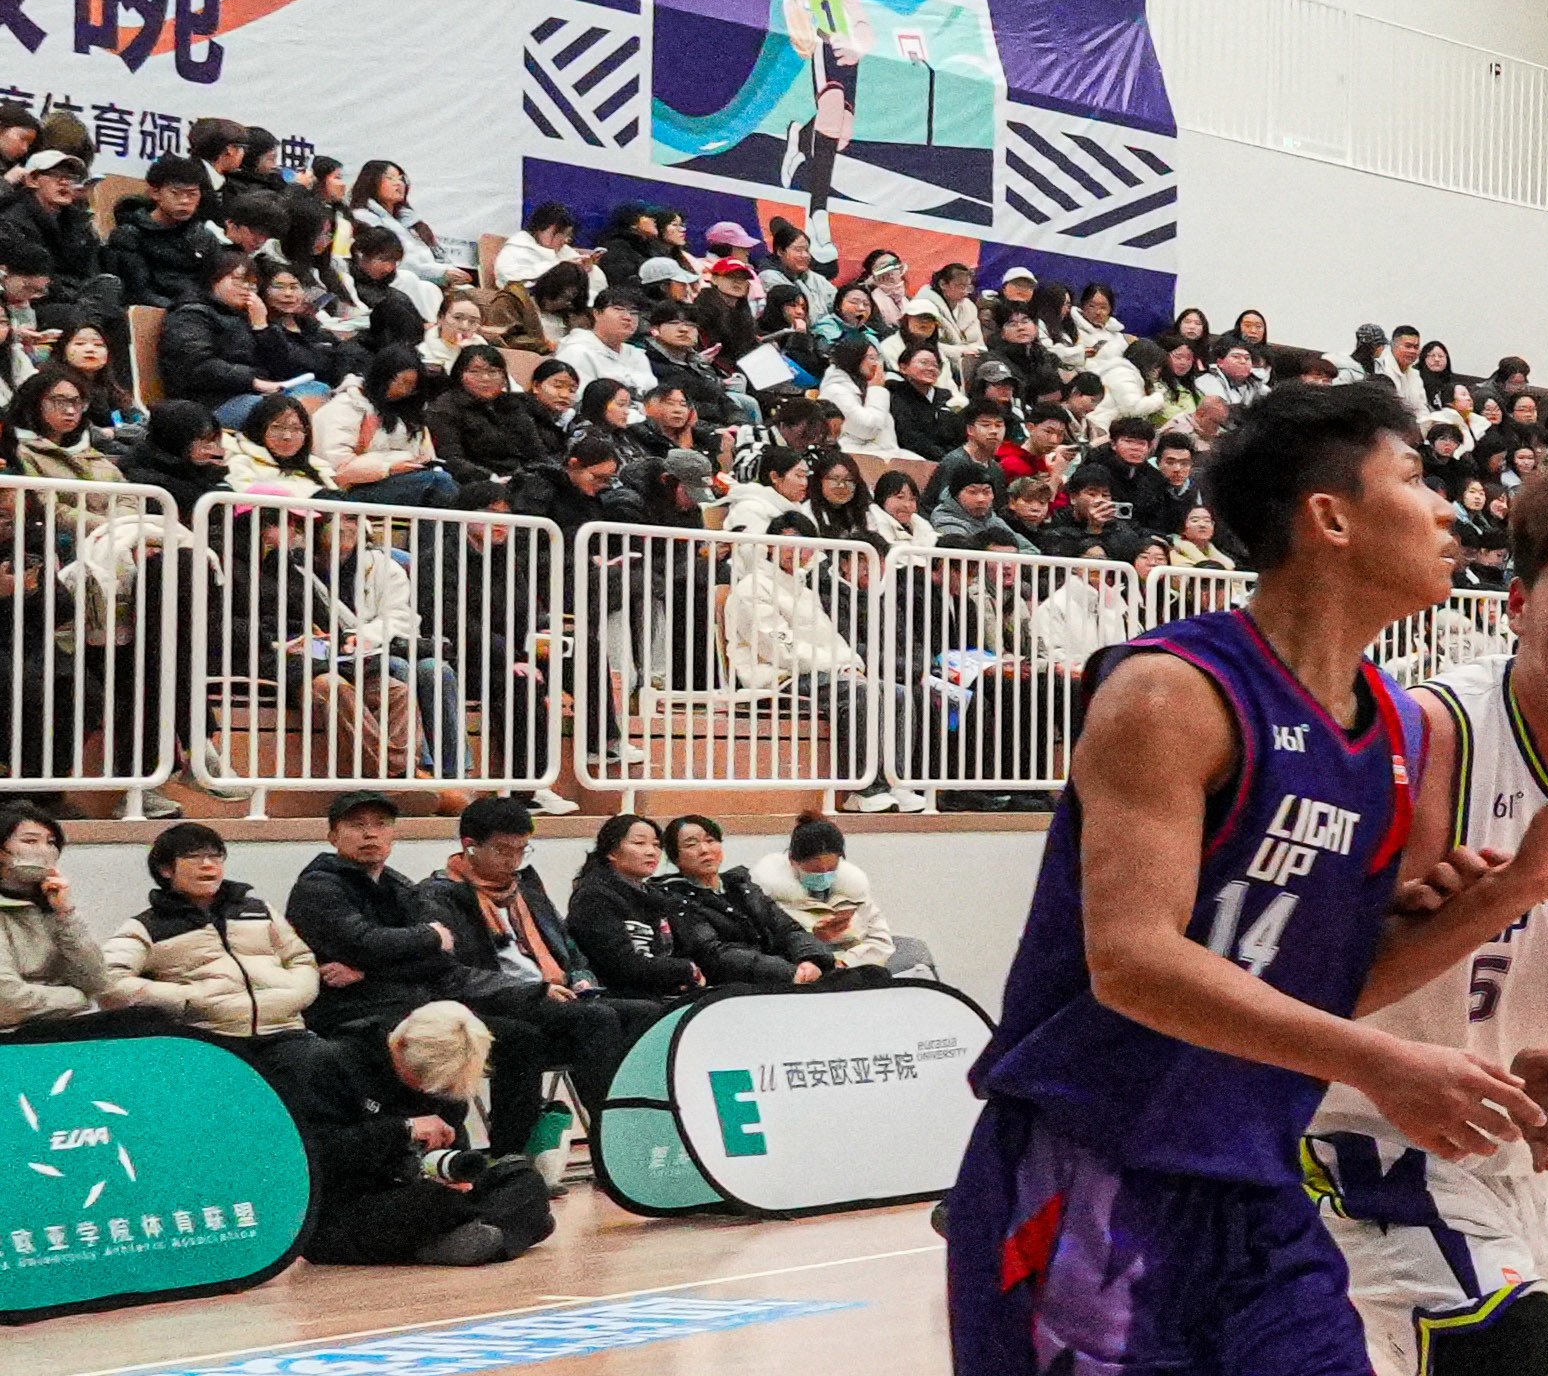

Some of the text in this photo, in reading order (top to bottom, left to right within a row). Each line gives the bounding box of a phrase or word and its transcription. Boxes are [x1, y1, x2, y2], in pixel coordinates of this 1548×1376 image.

[1266, 794, 1361, 855] LIGHT
[1247, 837, 1319, 886] UP
[1207, 880, 1300, 977] 14
[1470, 954, 1512, 1023] 5
[783, 1052, 918, 1090] 西安欧亚学院
[916, 1047, 967, 1062] UNIVERSITY
[0, 1201, 258, 1259] 欧亚学院体育联盟
